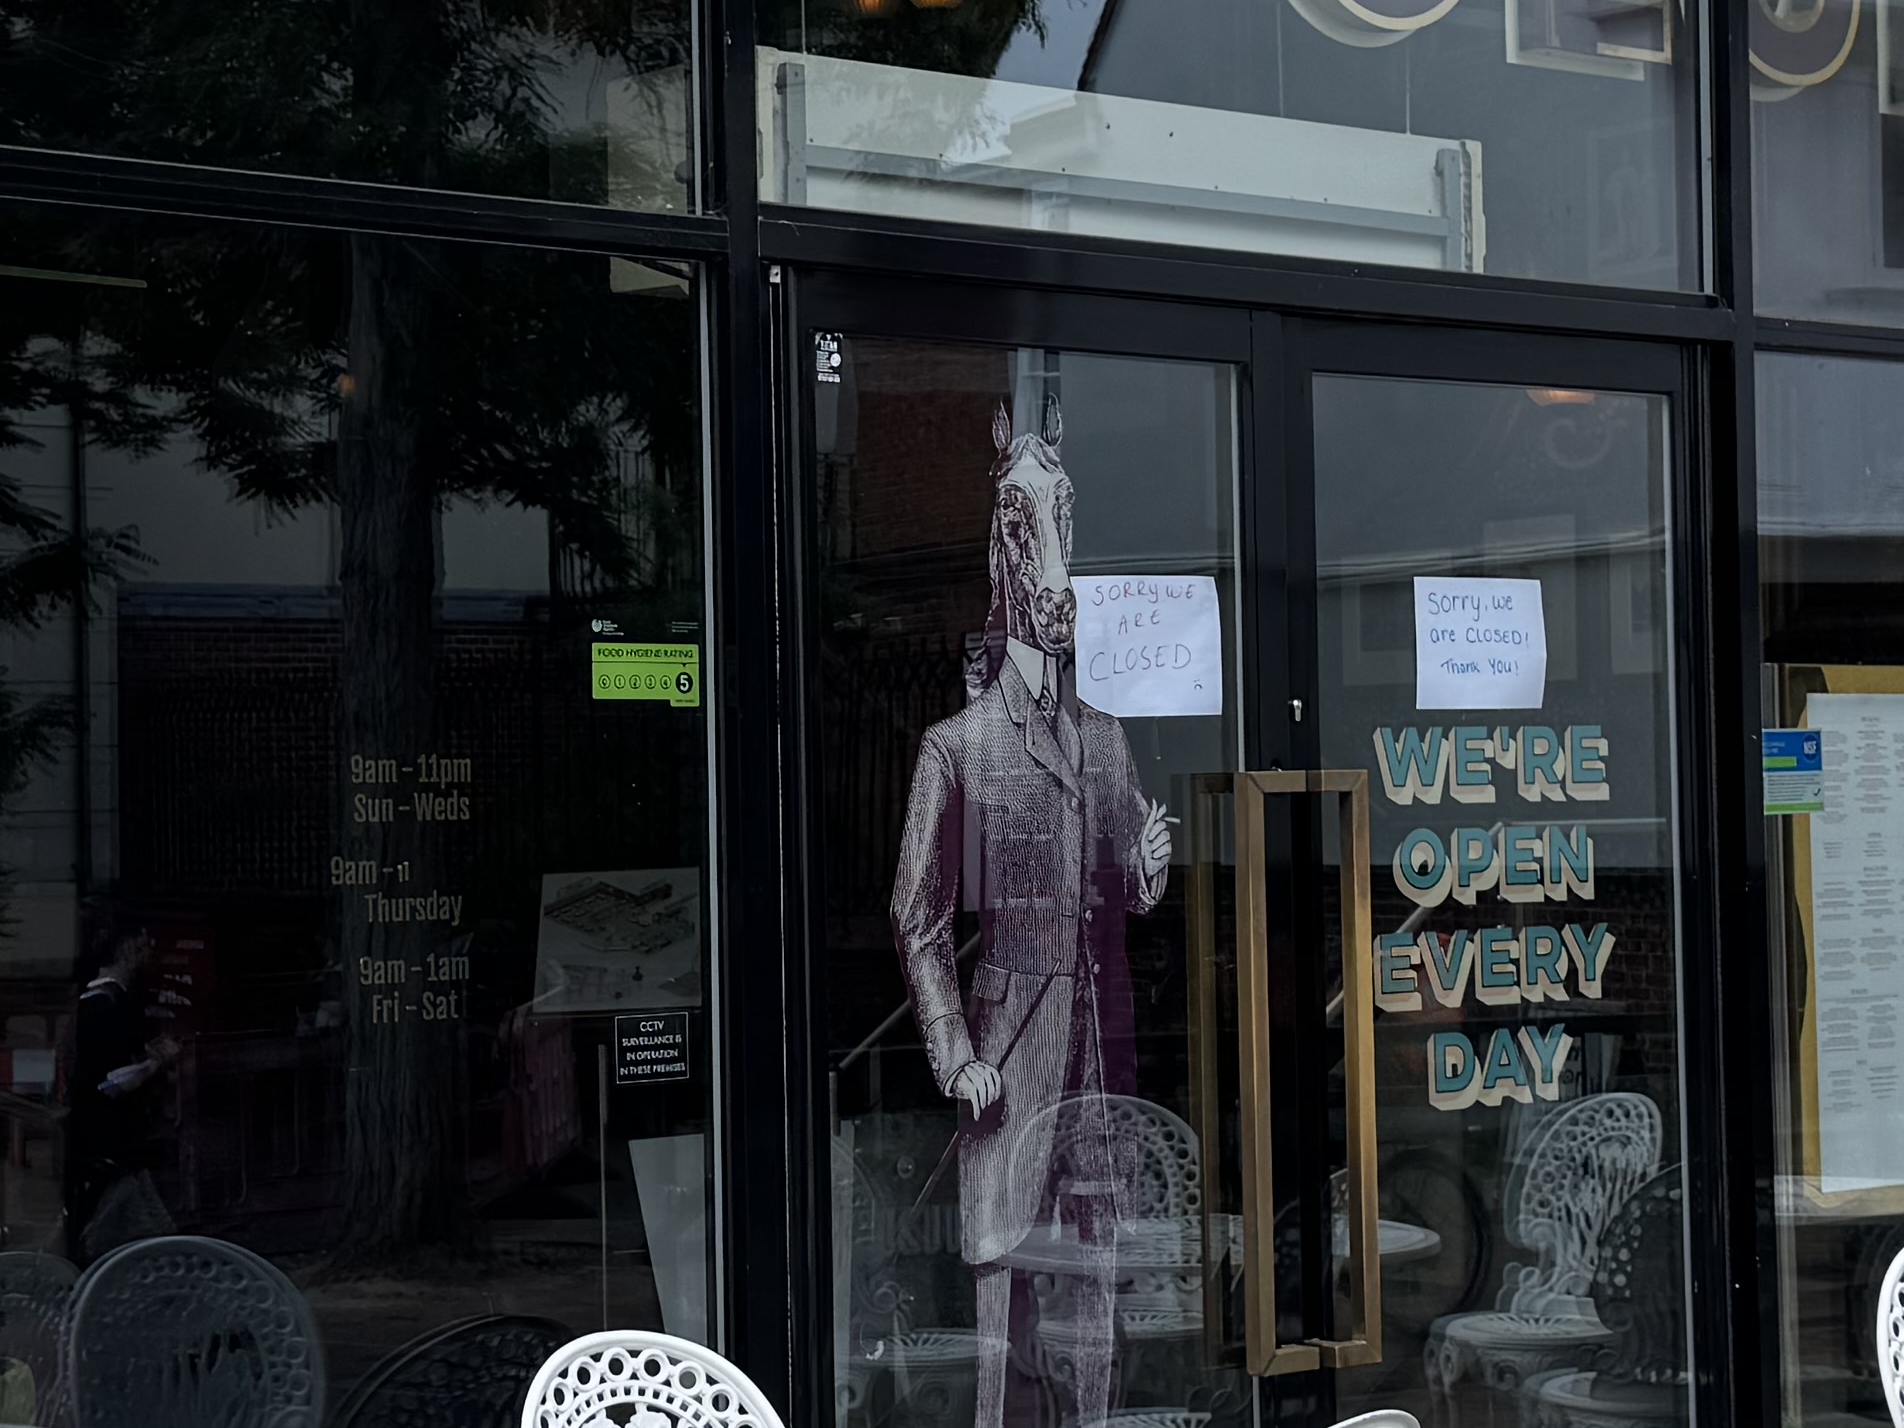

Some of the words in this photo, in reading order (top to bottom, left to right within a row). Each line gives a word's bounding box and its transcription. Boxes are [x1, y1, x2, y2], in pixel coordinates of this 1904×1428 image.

[1166, 584, 1195, 599] WE
[1492, 595, 1513, 611] we
[1118, 609, 1161, 635] ARE
[1430, 628, 1457, 643] are
[597, 648, 624, 658] FOOD
[626, 648, 662, 658] HYGIENE
[664, 649, 694, 659] RATING
[1089, 643, 1192, 681] CLOSED
[1440, 658, 1480, 674] Thank
[351, 754, 397, 784] 9am
[417, 753, 471, 789] 11pm
[1373, 725, 1610, 805] WE'RE
[353, 793, 394, 822] Sun
[414, 790, 470, 821] Weds
[330, 856, 377, 885] 9am
[1393, 825, 1595, 908] OPEN
[364, 889, 463, 926] Thursday
[359, 956, 406, 985] 9am
[427, 952, 470, 982] 1am
[1373, 922, 1616, 1012] EVERY
[372, 991, 399, 1024] Fri
[422, 990, 459, 1021] Sat
[639, 1020, 664, 1032] CCTV
[636, 1048, 678, 1060] OPERATION
[1426, 1023, 1573, 1111] DAY
